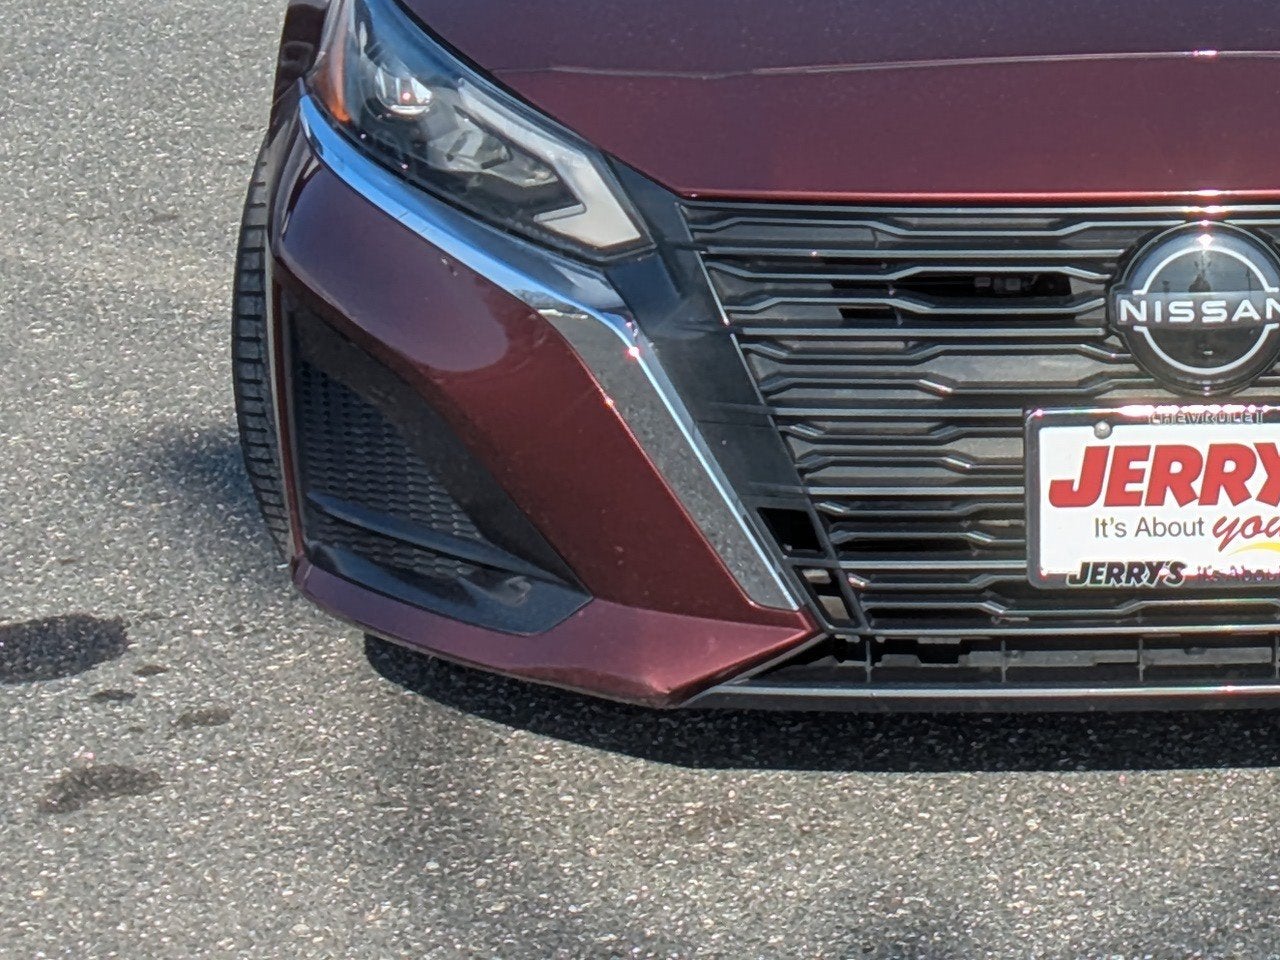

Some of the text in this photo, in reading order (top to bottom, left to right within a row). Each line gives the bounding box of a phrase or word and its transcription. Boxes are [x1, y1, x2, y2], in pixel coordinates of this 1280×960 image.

[1094, 517, 1127, 538] It's
[1134, 516, 1205, 538] About
[1066, 560, 1188, 588] JERRY'S
